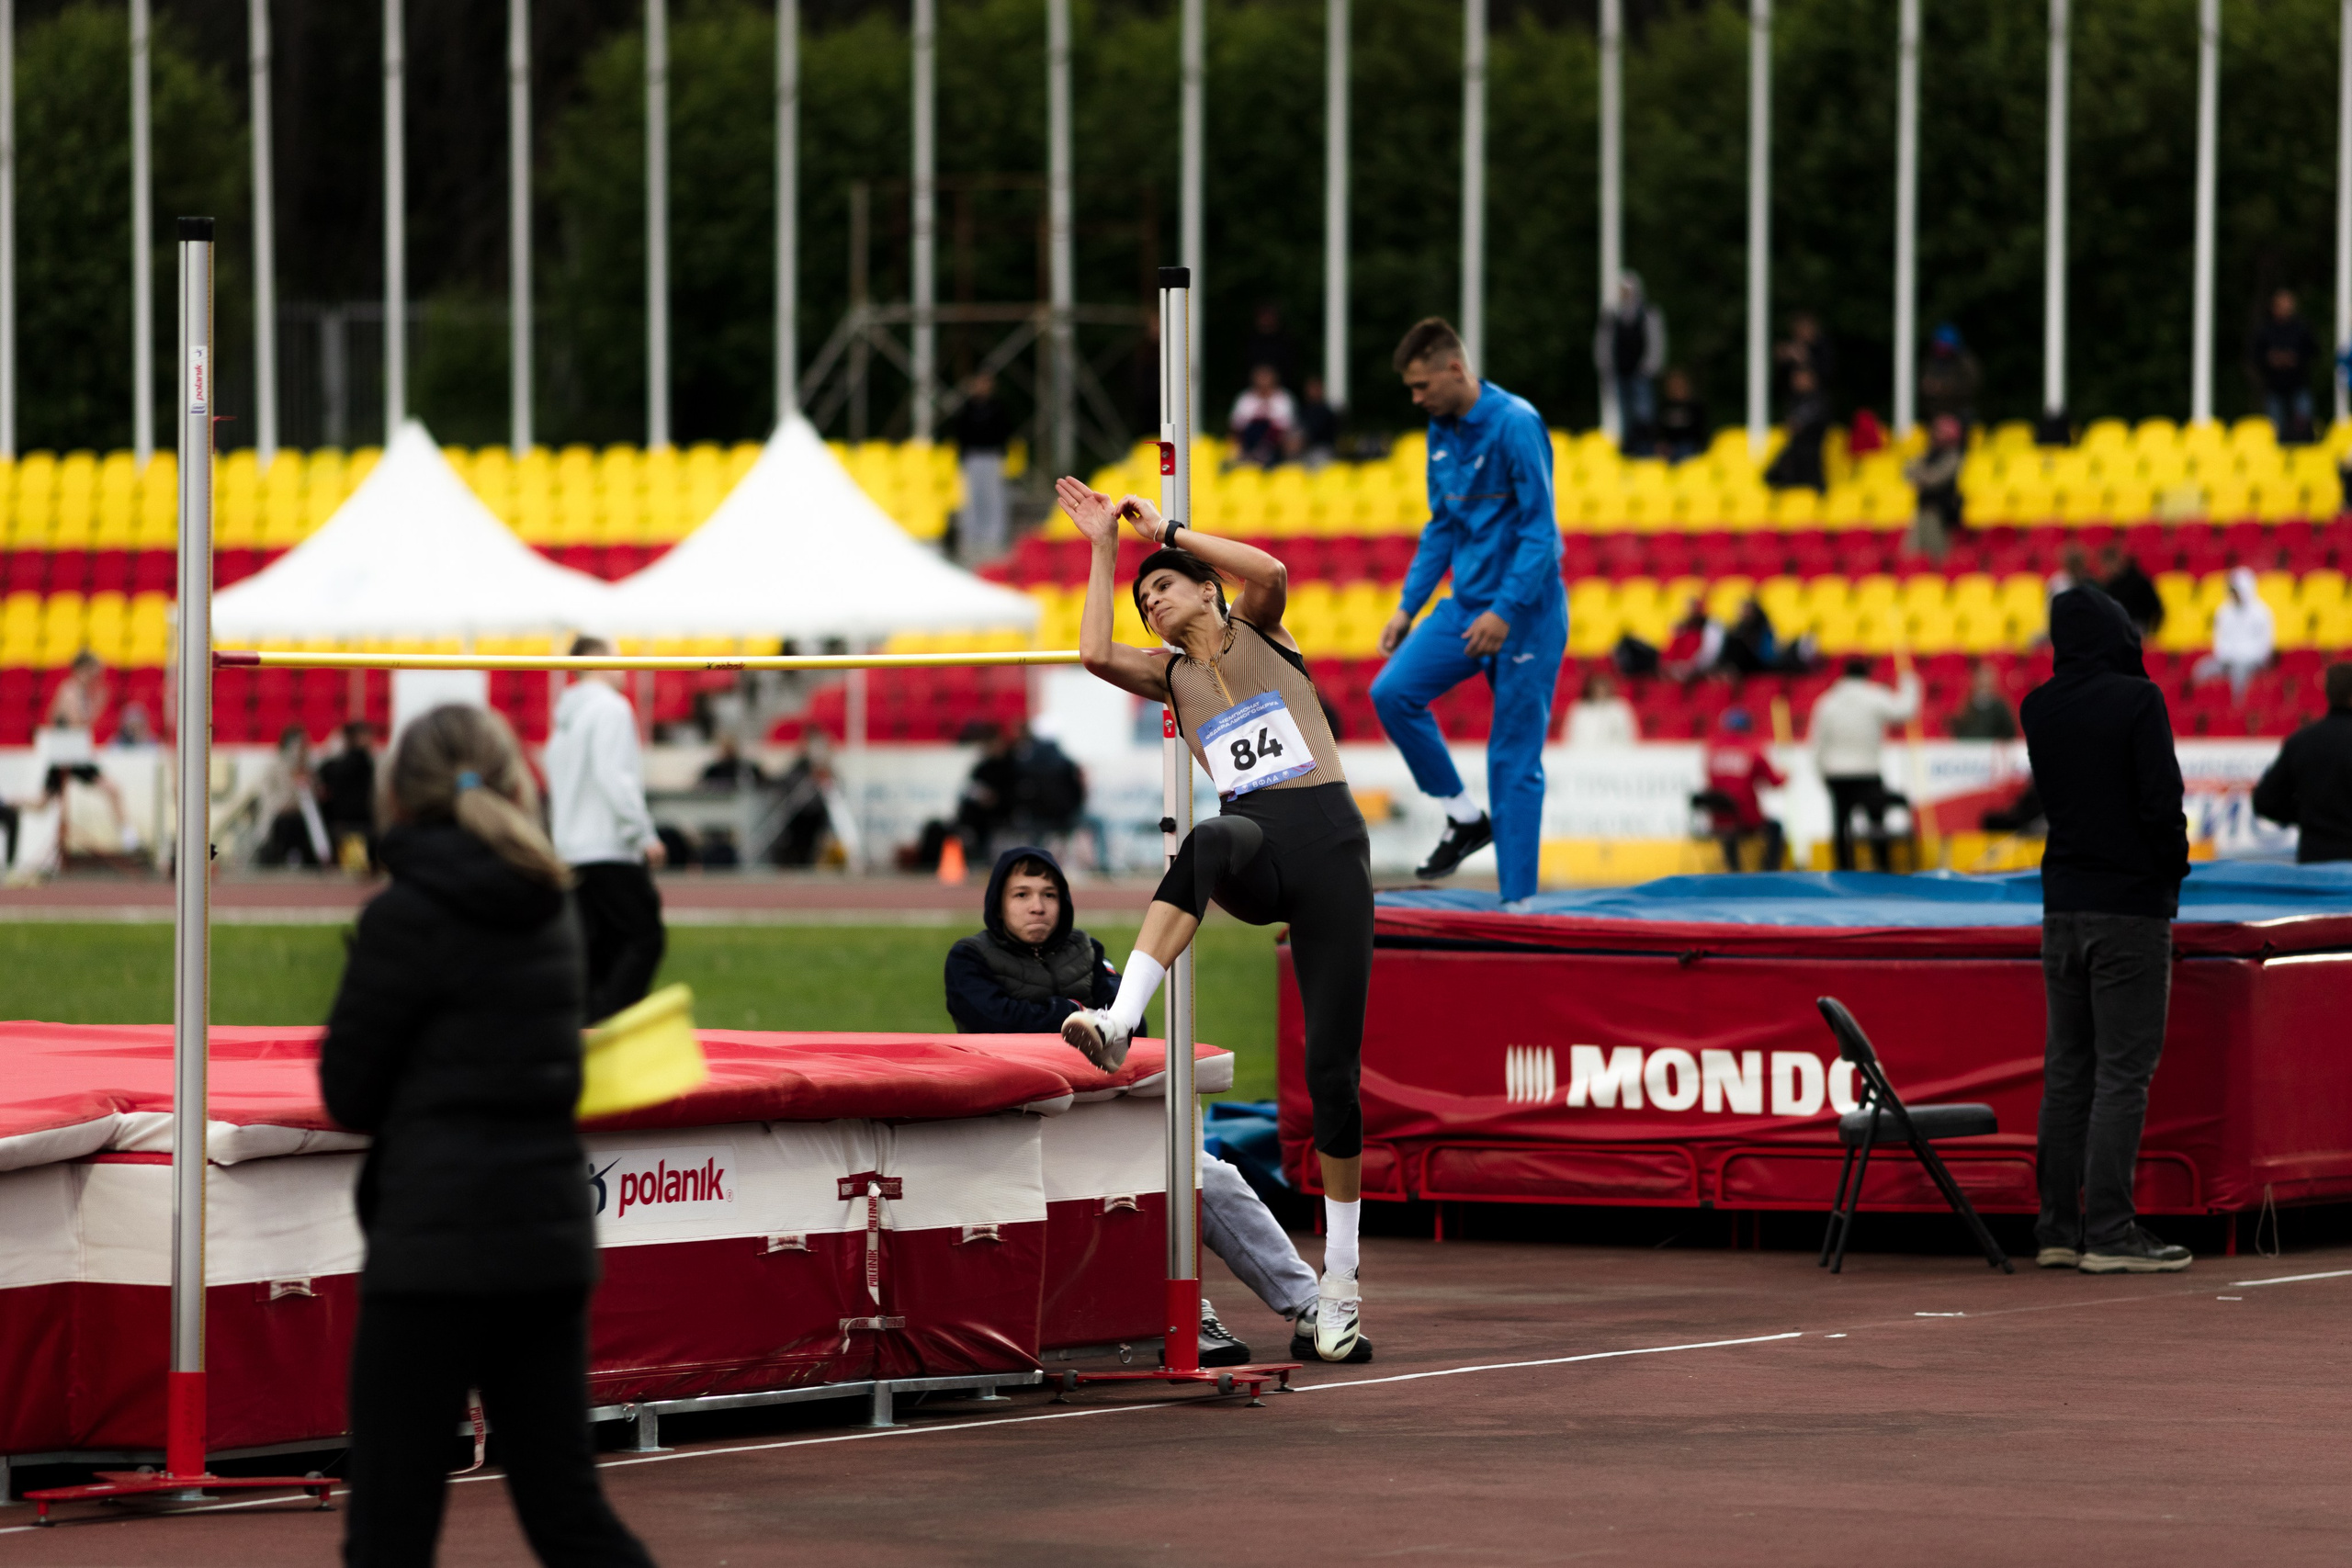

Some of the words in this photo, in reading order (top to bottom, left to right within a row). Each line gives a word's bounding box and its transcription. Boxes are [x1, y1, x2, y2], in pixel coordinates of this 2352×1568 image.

[195, 364, 205, 400] polanik
[1205, 709, 1256, 739] ФЕДЕРАЛЬНОГО
[1219, 702, 1260, 724] ЧЕМПИОНАТ
[1230, 728, 1283, 771] 84
[1252, 775, 1279, 788] ВФЛА
[618, 1156, 725, 1219] polanik
[868, 1195, 877, 1232] POLANIK
[867, 1249, 878, 1287] POLANIK
